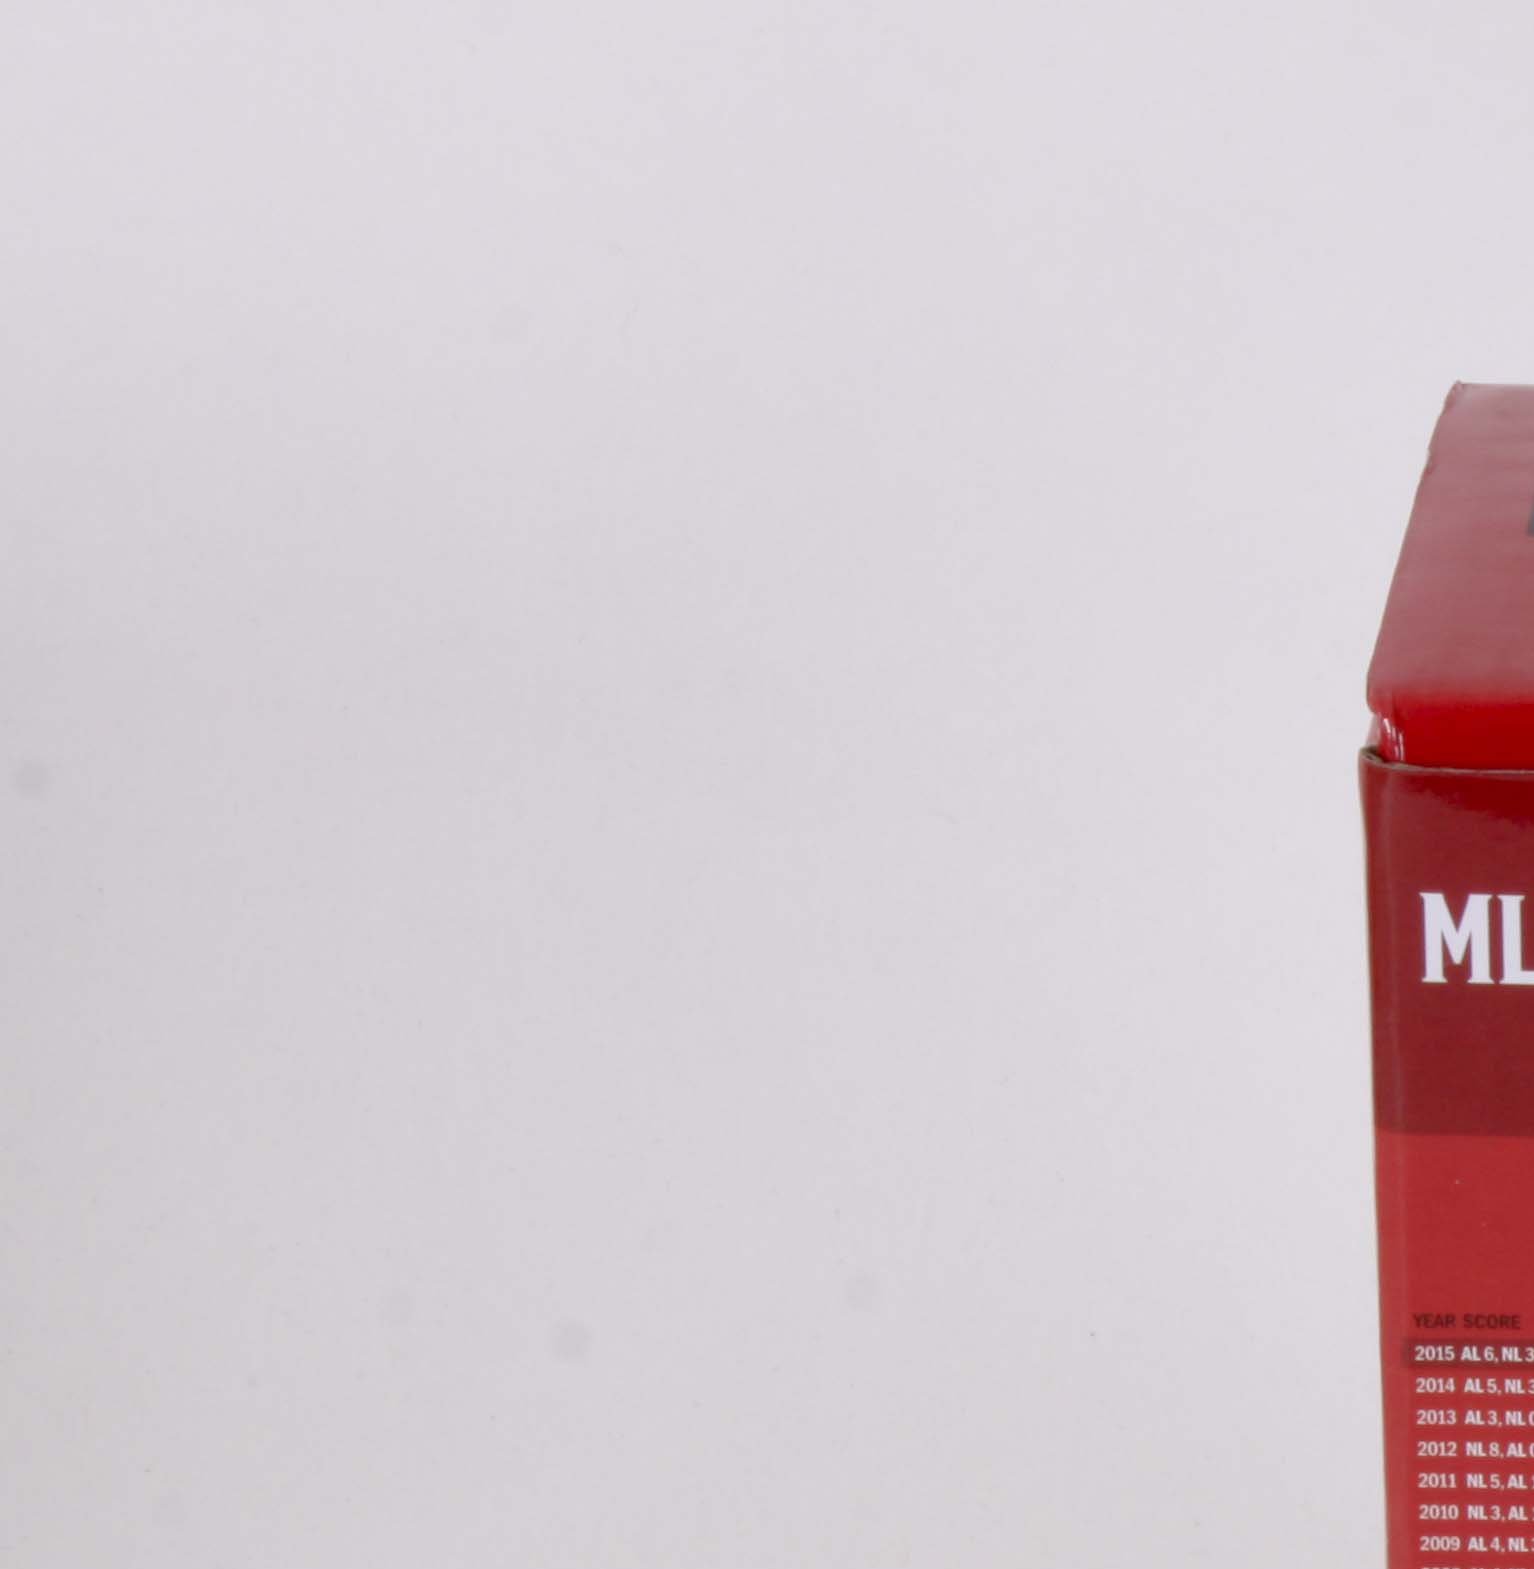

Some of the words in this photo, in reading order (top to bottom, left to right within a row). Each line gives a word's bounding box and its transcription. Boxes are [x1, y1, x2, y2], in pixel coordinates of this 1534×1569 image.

[1412, 1313, 1456, 1329] YEAR
[1463, 1313, 1521, 1331] SCORE
[1414, 1344, 1456, 1362] 2015
[1460, 1345, 1482, 1362] AL
[1501, 1345, 1524, 1363] NL
[1416, 1408, 1458, 1426] 2013
[1419, 1535, 1462, 1552] 2009
